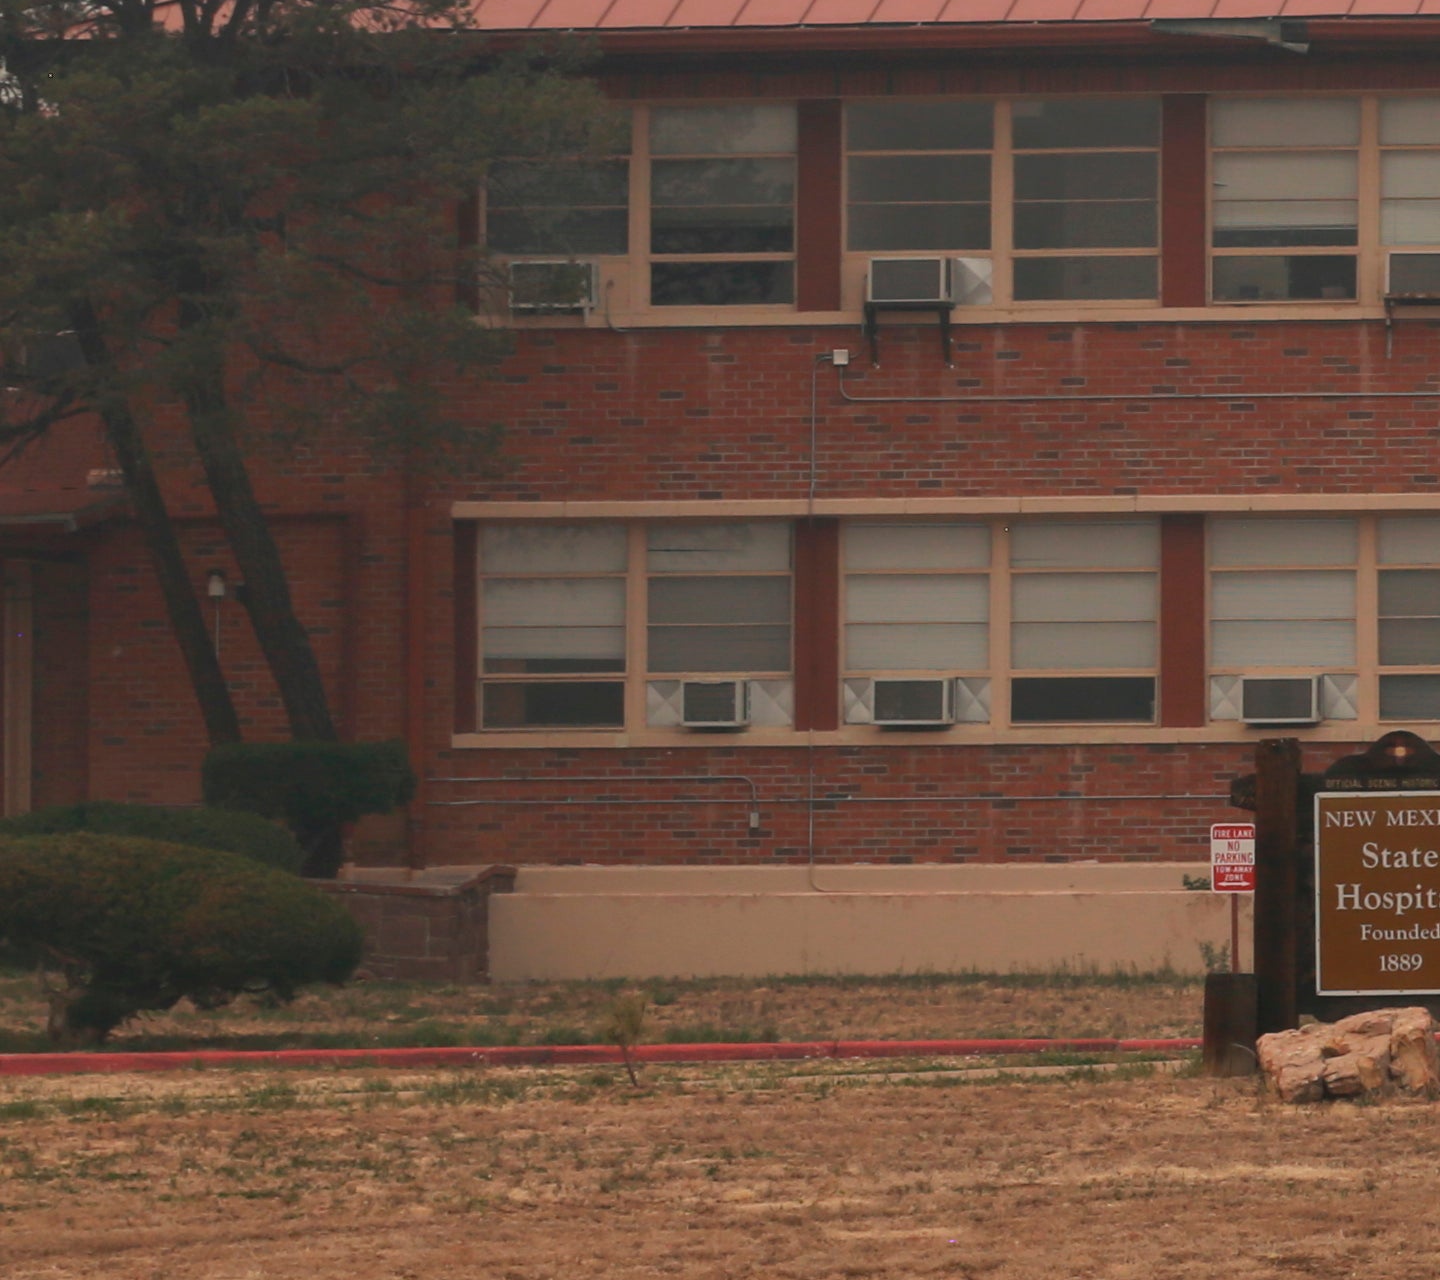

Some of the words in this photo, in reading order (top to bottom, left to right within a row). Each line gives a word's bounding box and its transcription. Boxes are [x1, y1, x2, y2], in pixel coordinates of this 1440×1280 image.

[1325, 810, 1377, 828] NEW
[1214, 829, 1230, 838] FIRE
[1233, 829, 1253, 838] LANE
[1227, 841, 1240, 851] NO
[1215, 852, 1253, 863] PARKING
[1361, 842, 1439, 869] State
[1224, 874, 1244, 882] ZONE
[1378, 953, 1423, 973] 1889
